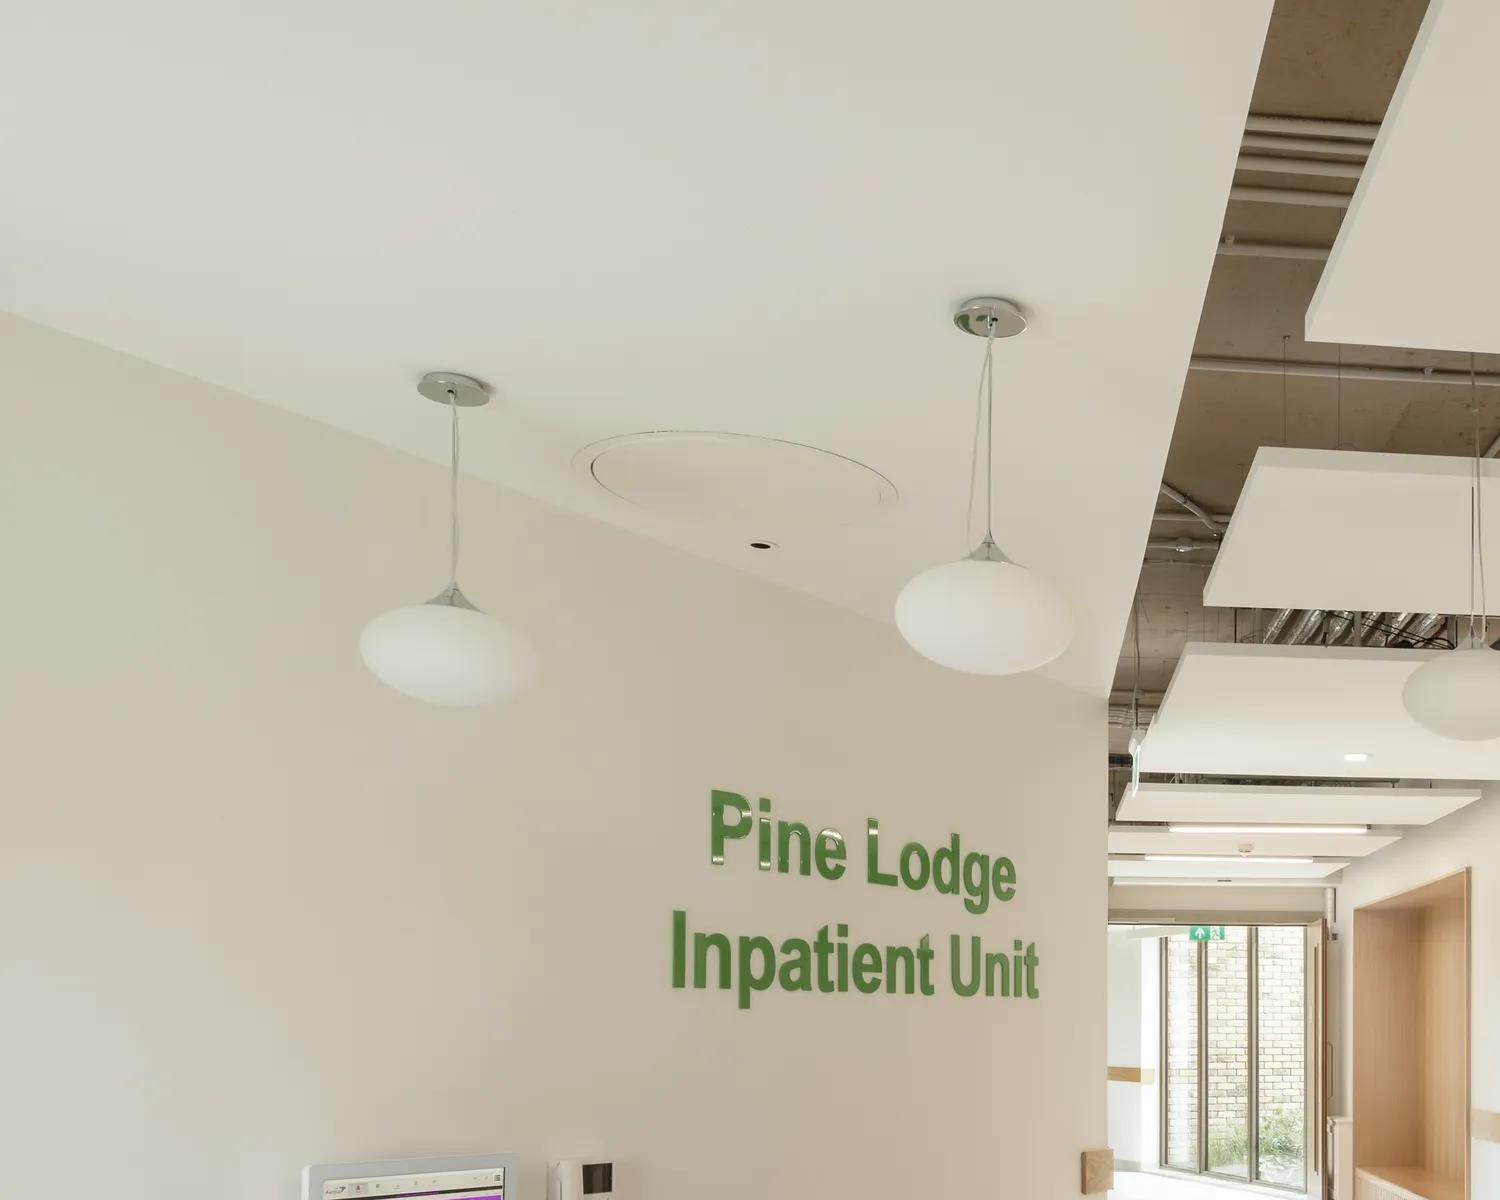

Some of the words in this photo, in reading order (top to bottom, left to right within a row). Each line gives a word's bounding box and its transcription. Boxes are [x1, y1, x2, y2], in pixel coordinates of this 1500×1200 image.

[711, 789, 847, 881] Pine
[867, 816, 1017, 915] Lodge
[672, 910, 936, 1010] Inpatient
[950, 934, 1040, 999] Unit
